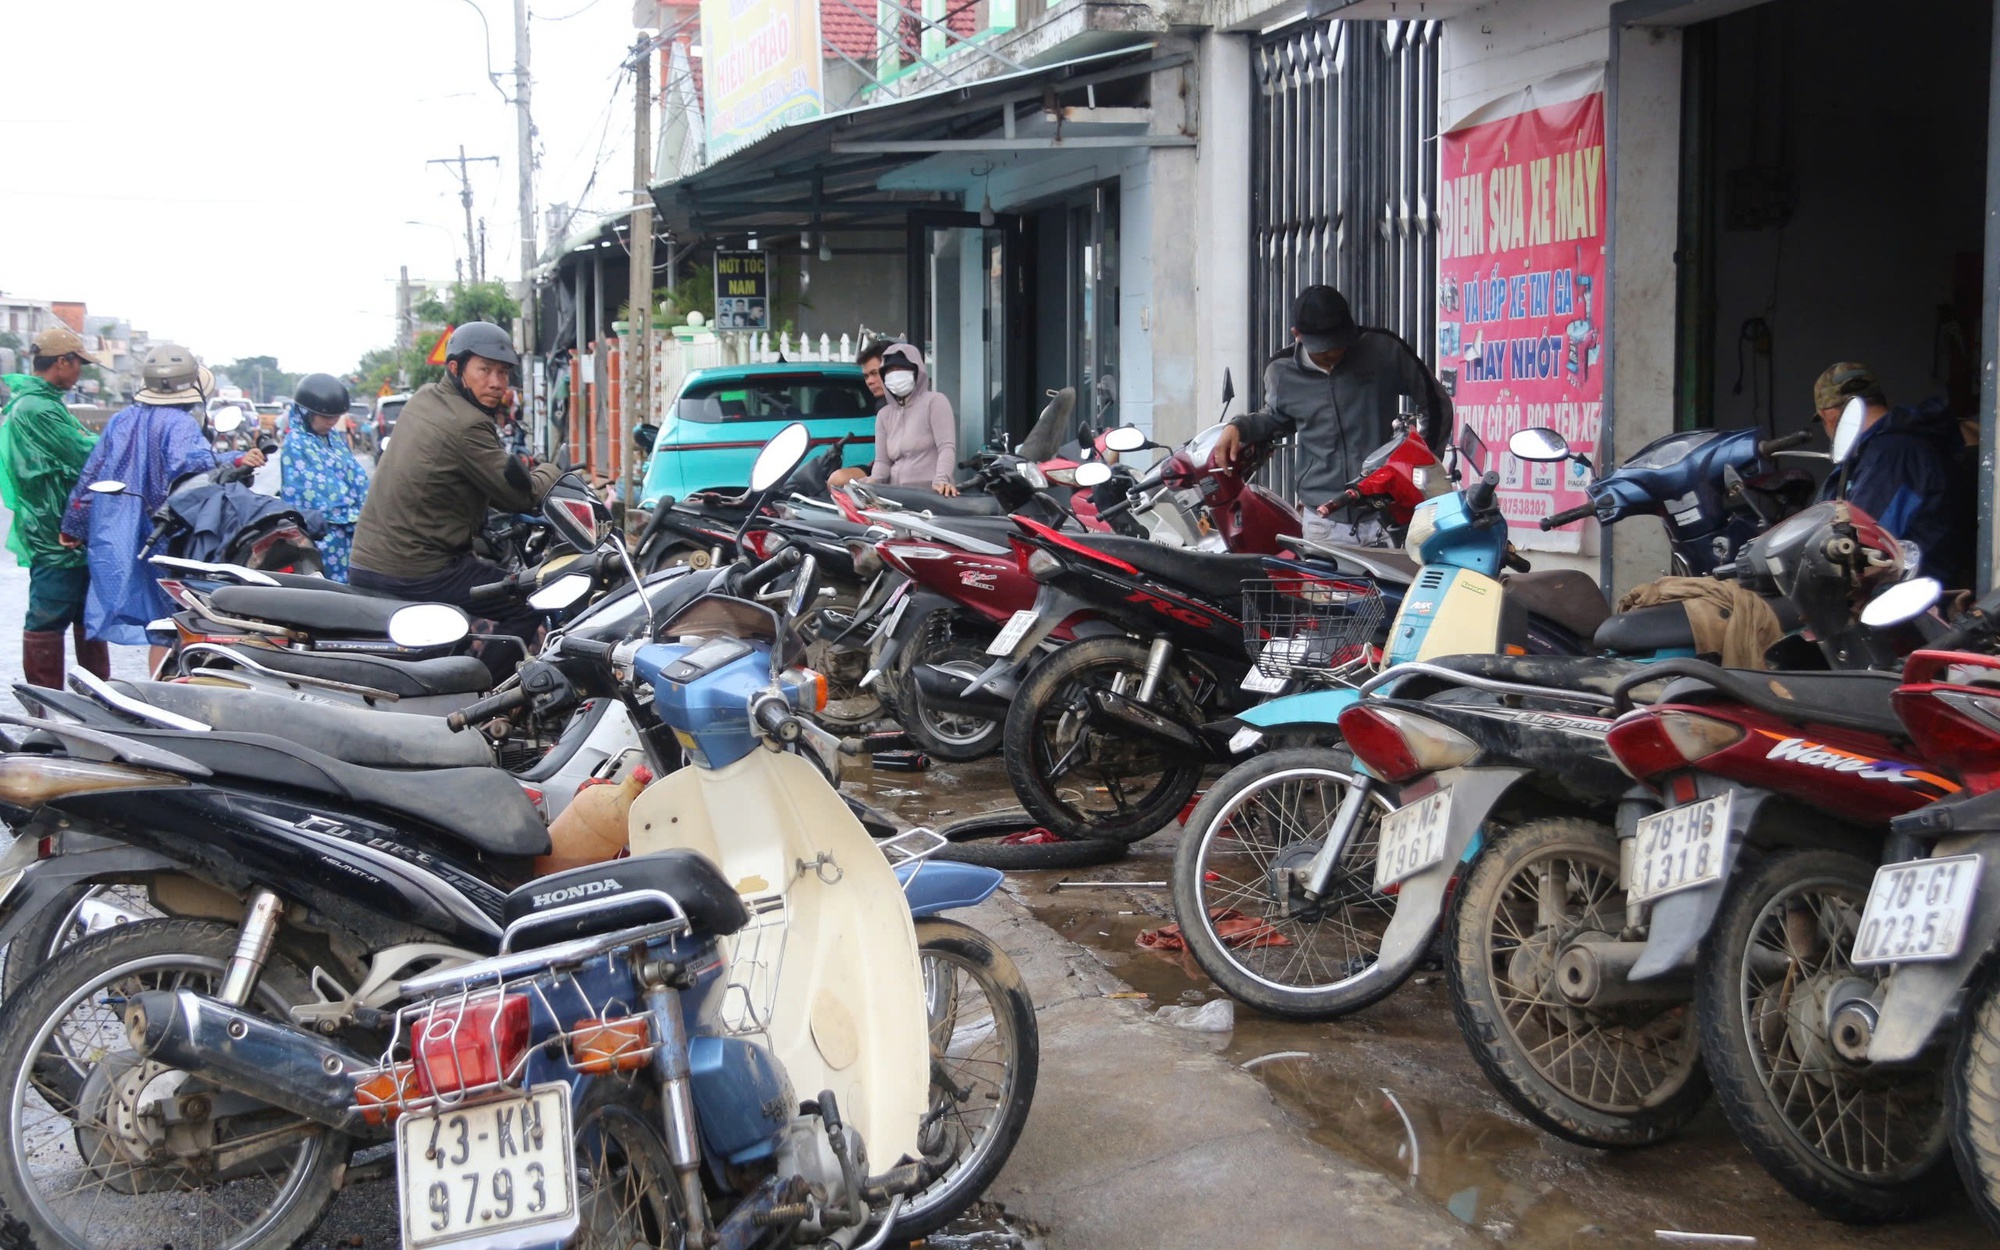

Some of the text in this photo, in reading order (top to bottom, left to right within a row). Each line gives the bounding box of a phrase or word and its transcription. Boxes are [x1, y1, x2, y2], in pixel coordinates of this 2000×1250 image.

[1441, 129, 1602, 259] ĐIỂM SỬA XE MÁY
[728, 280, 756, 295] NAM
[1464, 263, 1574, 324] VÁ LỐP XE TAY GA
[1511, 326, 1563, 380] NHỚT
[320, 856, 380, 883] HELMET-IN
[1383, 830, 1433, 883] 7961
[1640, 843, 1712, 893] 1318
[533, 877, 622, 908] HONDA
[425, 1100, 543, 1170] 43-KN
